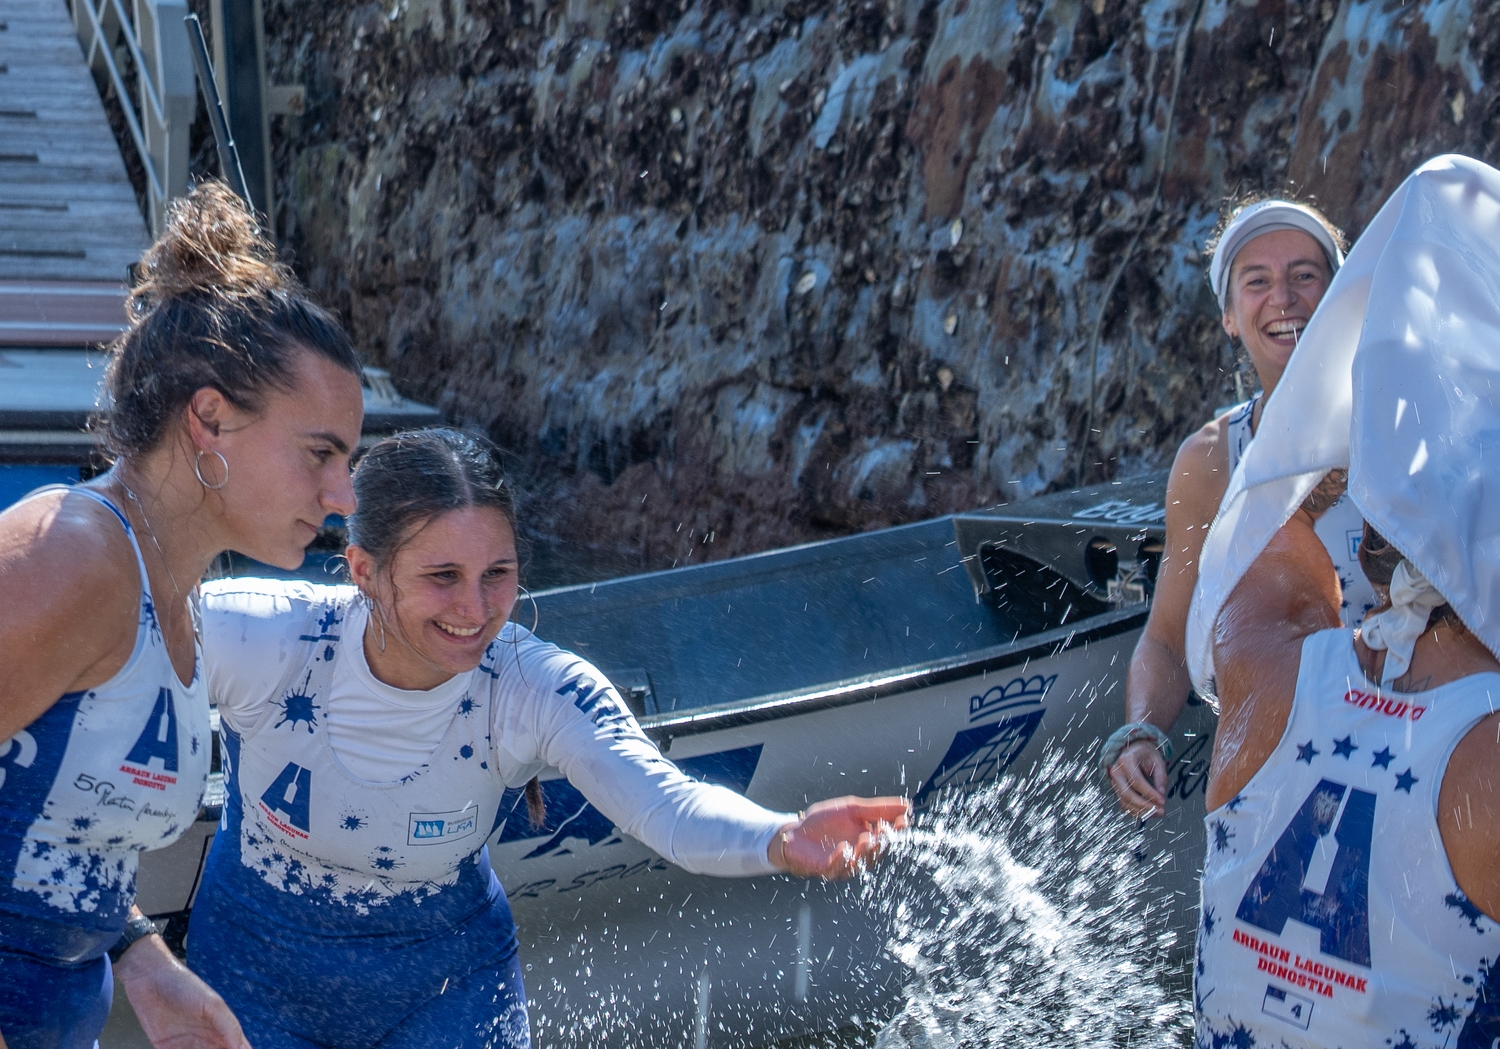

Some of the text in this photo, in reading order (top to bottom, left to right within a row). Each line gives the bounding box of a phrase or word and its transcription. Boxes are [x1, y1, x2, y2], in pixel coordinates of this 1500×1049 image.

[1344, 688, 1428, 722] amura
[1232, 928, 1369, 994] ARRAUN LAGUNAK
[1257, 957, 1334, 998] DONOSTIA
